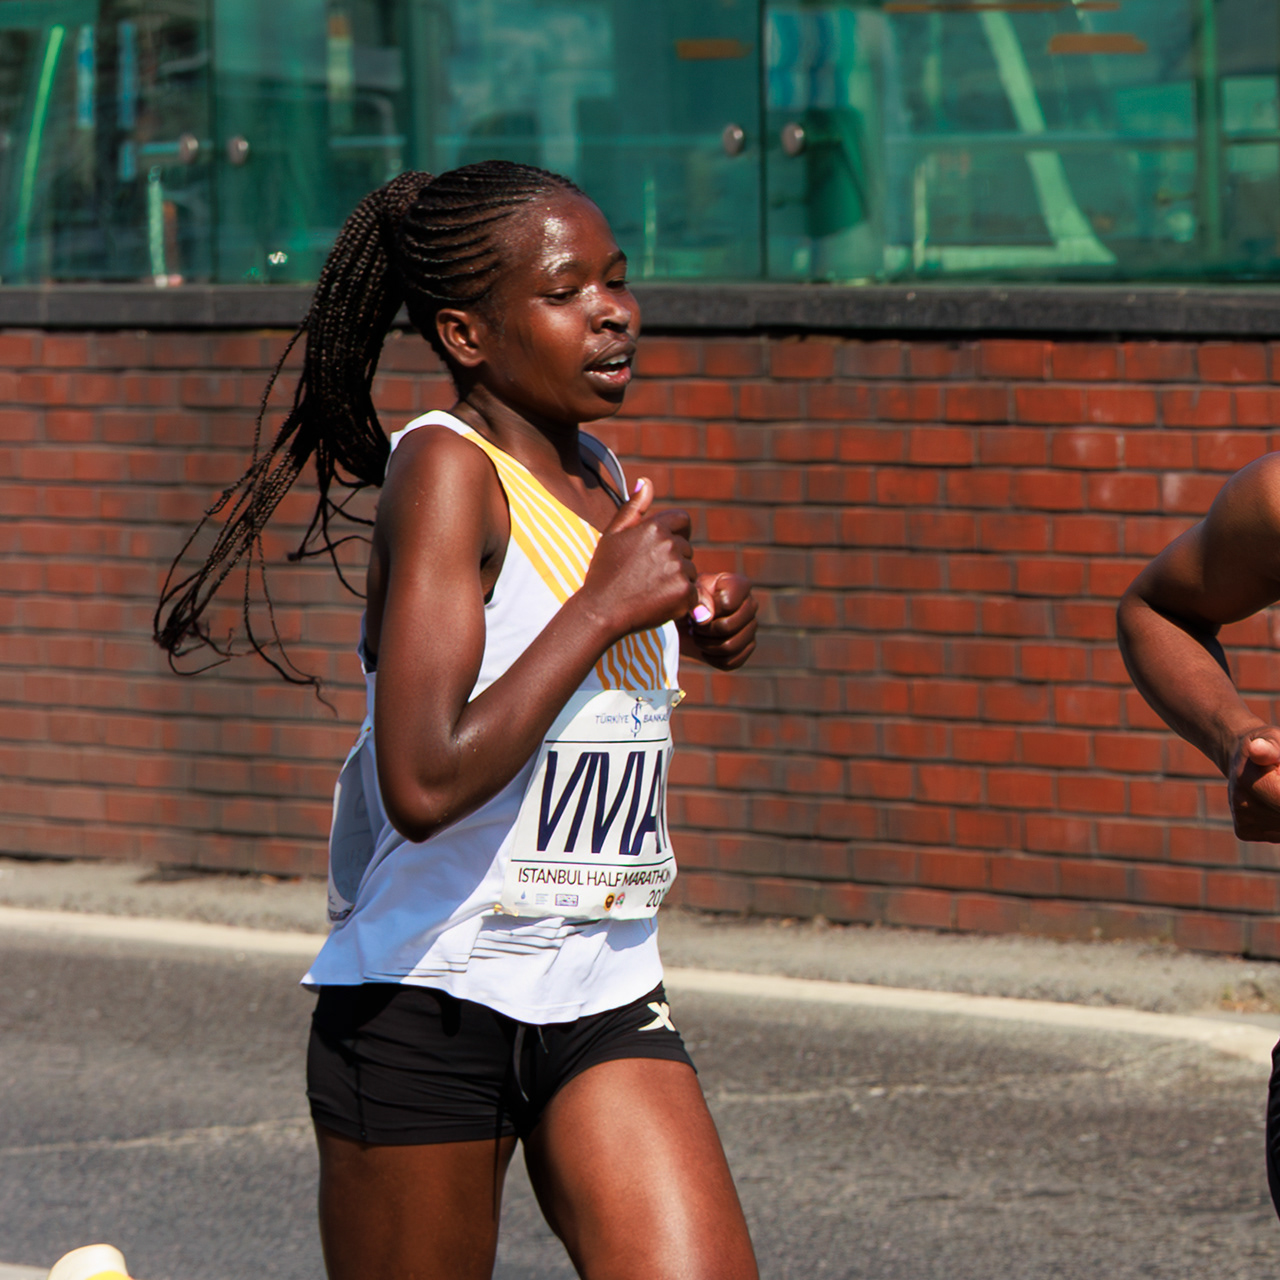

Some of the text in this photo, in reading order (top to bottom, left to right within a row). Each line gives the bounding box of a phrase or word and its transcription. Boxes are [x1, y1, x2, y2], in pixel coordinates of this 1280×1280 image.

[595, 711, 629, 724] TÜRKİYE
[518, 867, 584, 885] ISTANBUL
[586, 870, 622, 887] HALF
